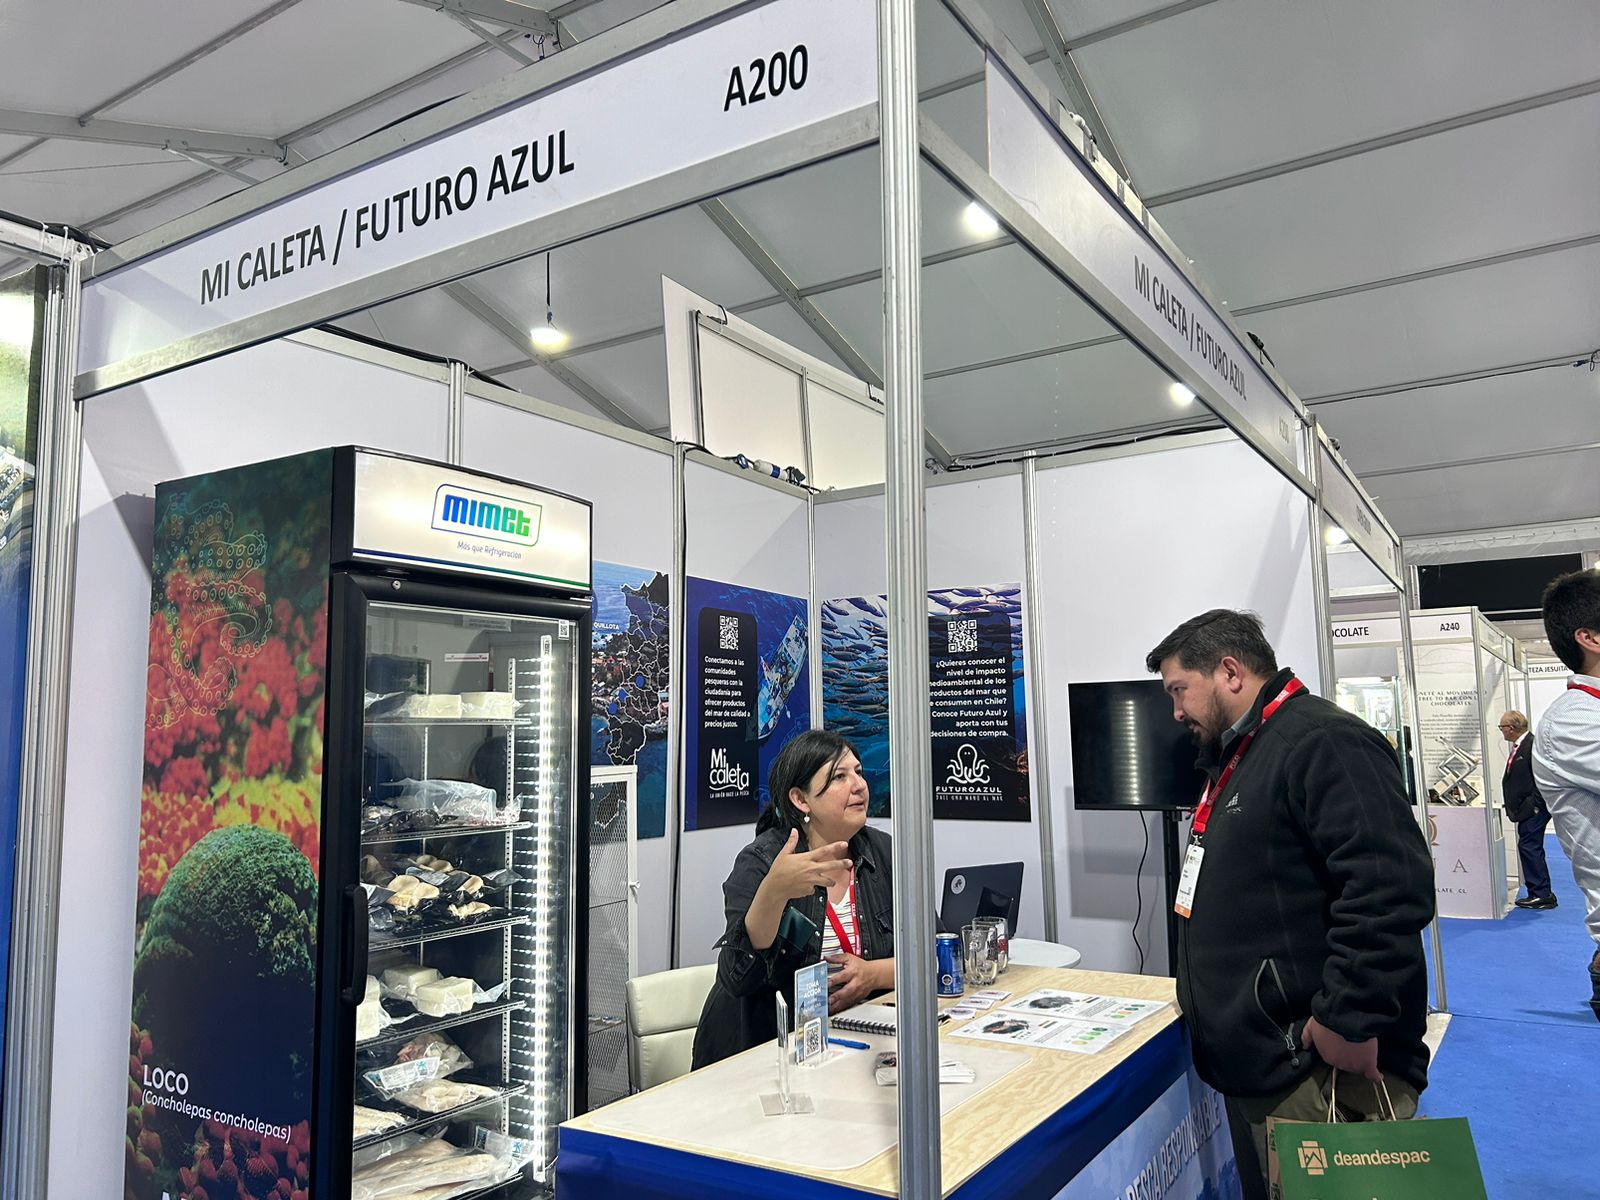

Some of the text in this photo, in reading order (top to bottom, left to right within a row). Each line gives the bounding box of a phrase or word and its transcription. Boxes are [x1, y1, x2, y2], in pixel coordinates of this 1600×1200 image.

[724, 44, 808, 112] A200
[201, 129, 575, 304] MI CALETA / FUTURO AZUL
[1134, 255, 1247, 401] MI CALETA / FUTURO AZUL
[472, 545, 484, 554] que
[593, 622, 620, 630] QUILLOTA
[1440, 622, 1460, 631] A240
[704, 655, 733, 665] Conectamos
[935, 659, 966, 668] ¿Quieres
[998, 656, 1005, 664] el
[704, 667, 736, 675] comunidades
[965, 668, 974, 676] de
[975, 667, 1006, 675] impacto
[704, 678, 729, 686] pesqueras
[984, 677, 994, 685] de
[992, 688, 1007, 696] que
[704, 698, 746, 707] ofrecer productos
[984, 697, 1007, 705] Chile?
[730, 709, 747, 717] calidad
[931, 710, 958, 718] Conoce
[959, 709, 984, 717] Futuro
[1002, 709, 1008, 717] y
[704, 720, 722, 729] precios
[955, 720, 979, 728] aporta
[978, 730, 1008, 738] compra.
[711, 748, 727, 769] Mi
[709, 763, 749, 790] caleta
[143, 1064, 189, 1096] LOCO
[141, 1089, 292, 1144] (Concholepas concholepas)
[1160, 1090, 1222, 1196] RESPONSABLE
[1333, 1149, 1431, 1168] deandespac
